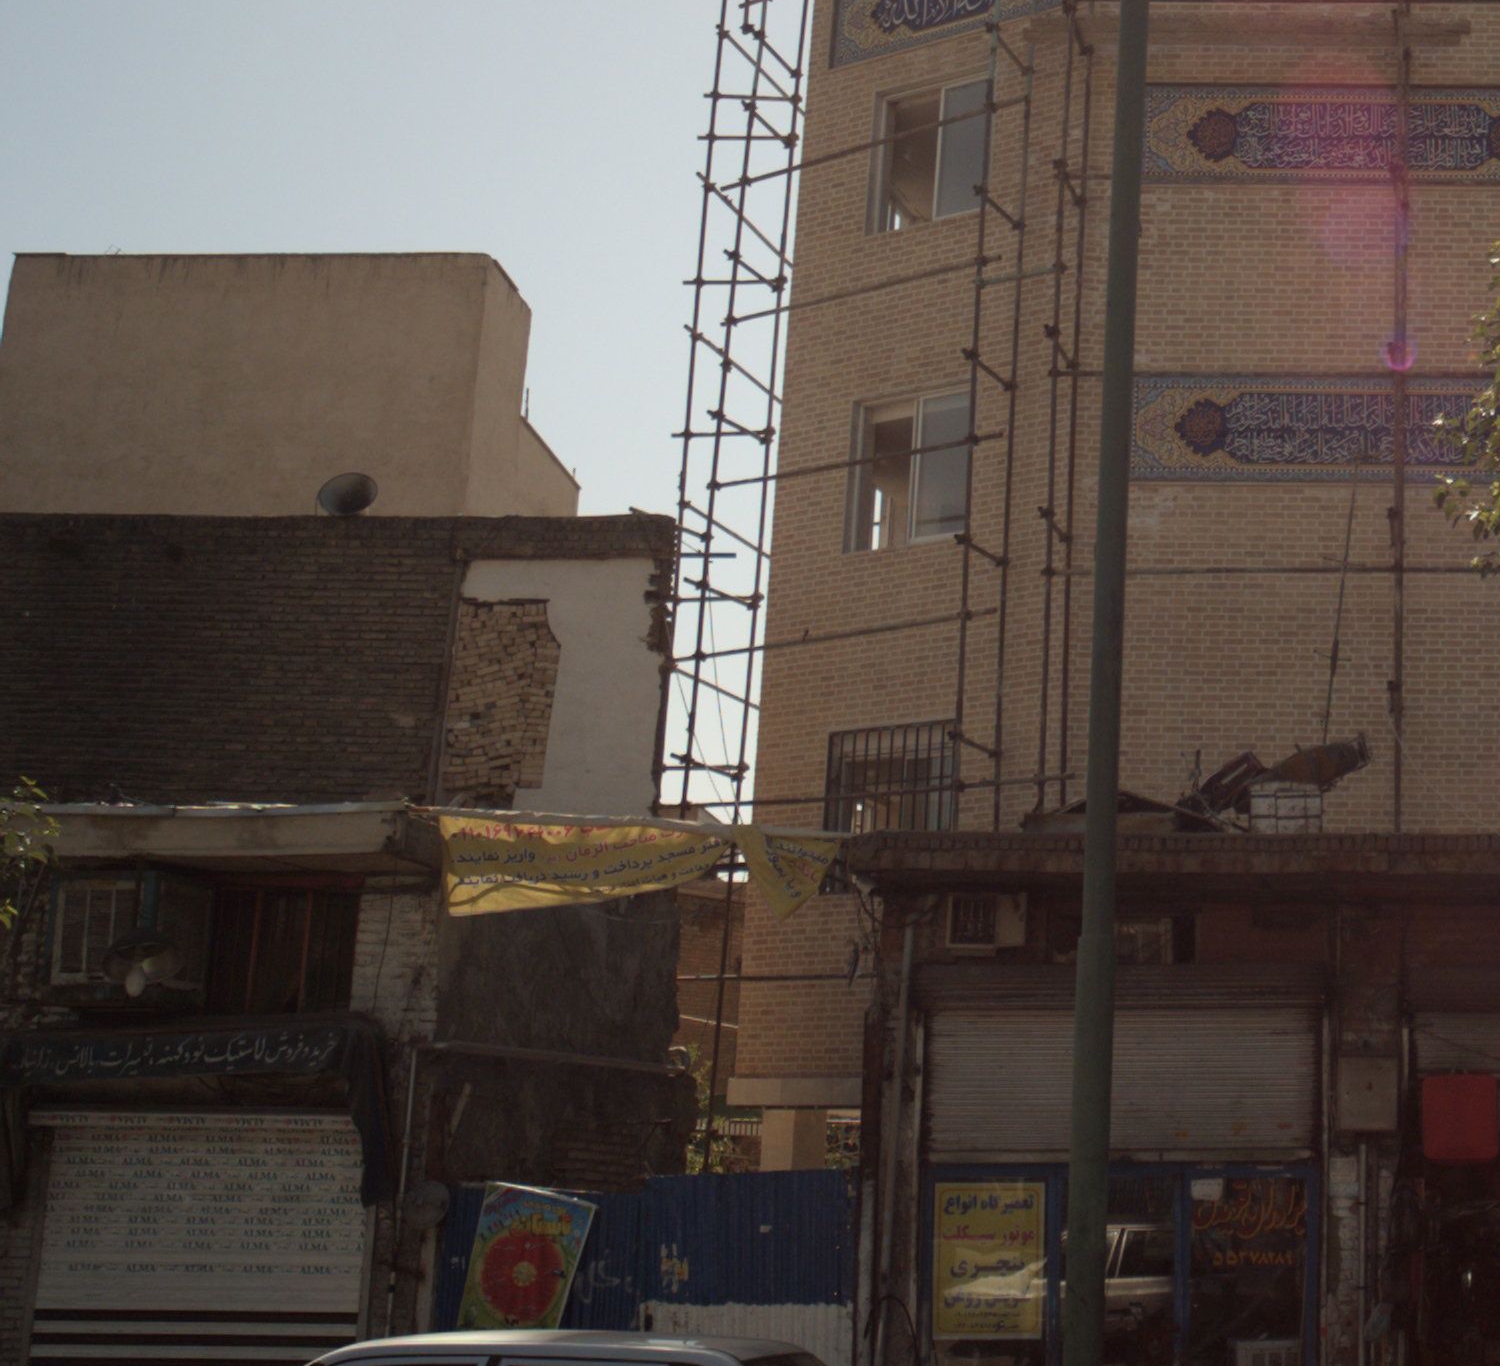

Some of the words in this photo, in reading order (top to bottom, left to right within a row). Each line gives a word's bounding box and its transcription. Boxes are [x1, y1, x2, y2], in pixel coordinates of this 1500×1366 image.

[203, 1033, 267, 1072] لاستیک
[308, 1032, 339, 1068] خرید
[943, 1193, 978, 1215] انواع
